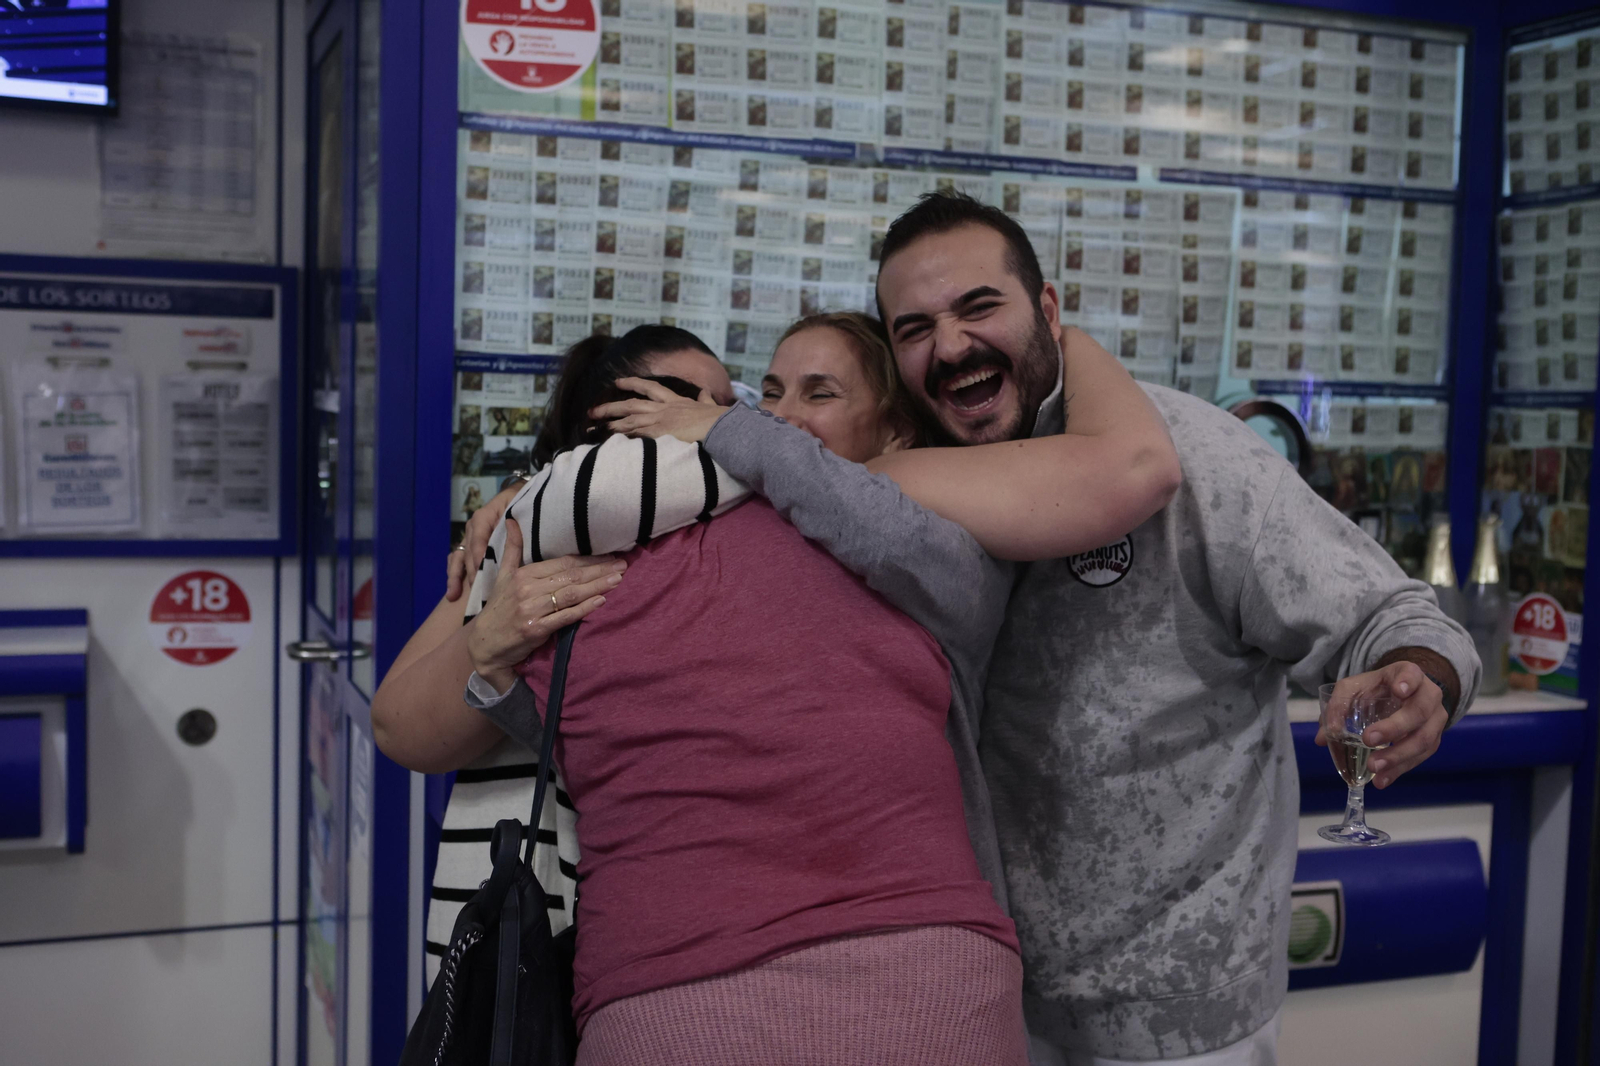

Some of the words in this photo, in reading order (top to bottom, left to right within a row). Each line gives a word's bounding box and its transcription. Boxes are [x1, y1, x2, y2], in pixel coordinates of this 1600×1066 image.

[28, 286, 70, 306] LOS
[74, 289, 172, 310] SORTEOS
[169, 578, 230, 612] +18
[1523, 602, 1557, 631] +18
